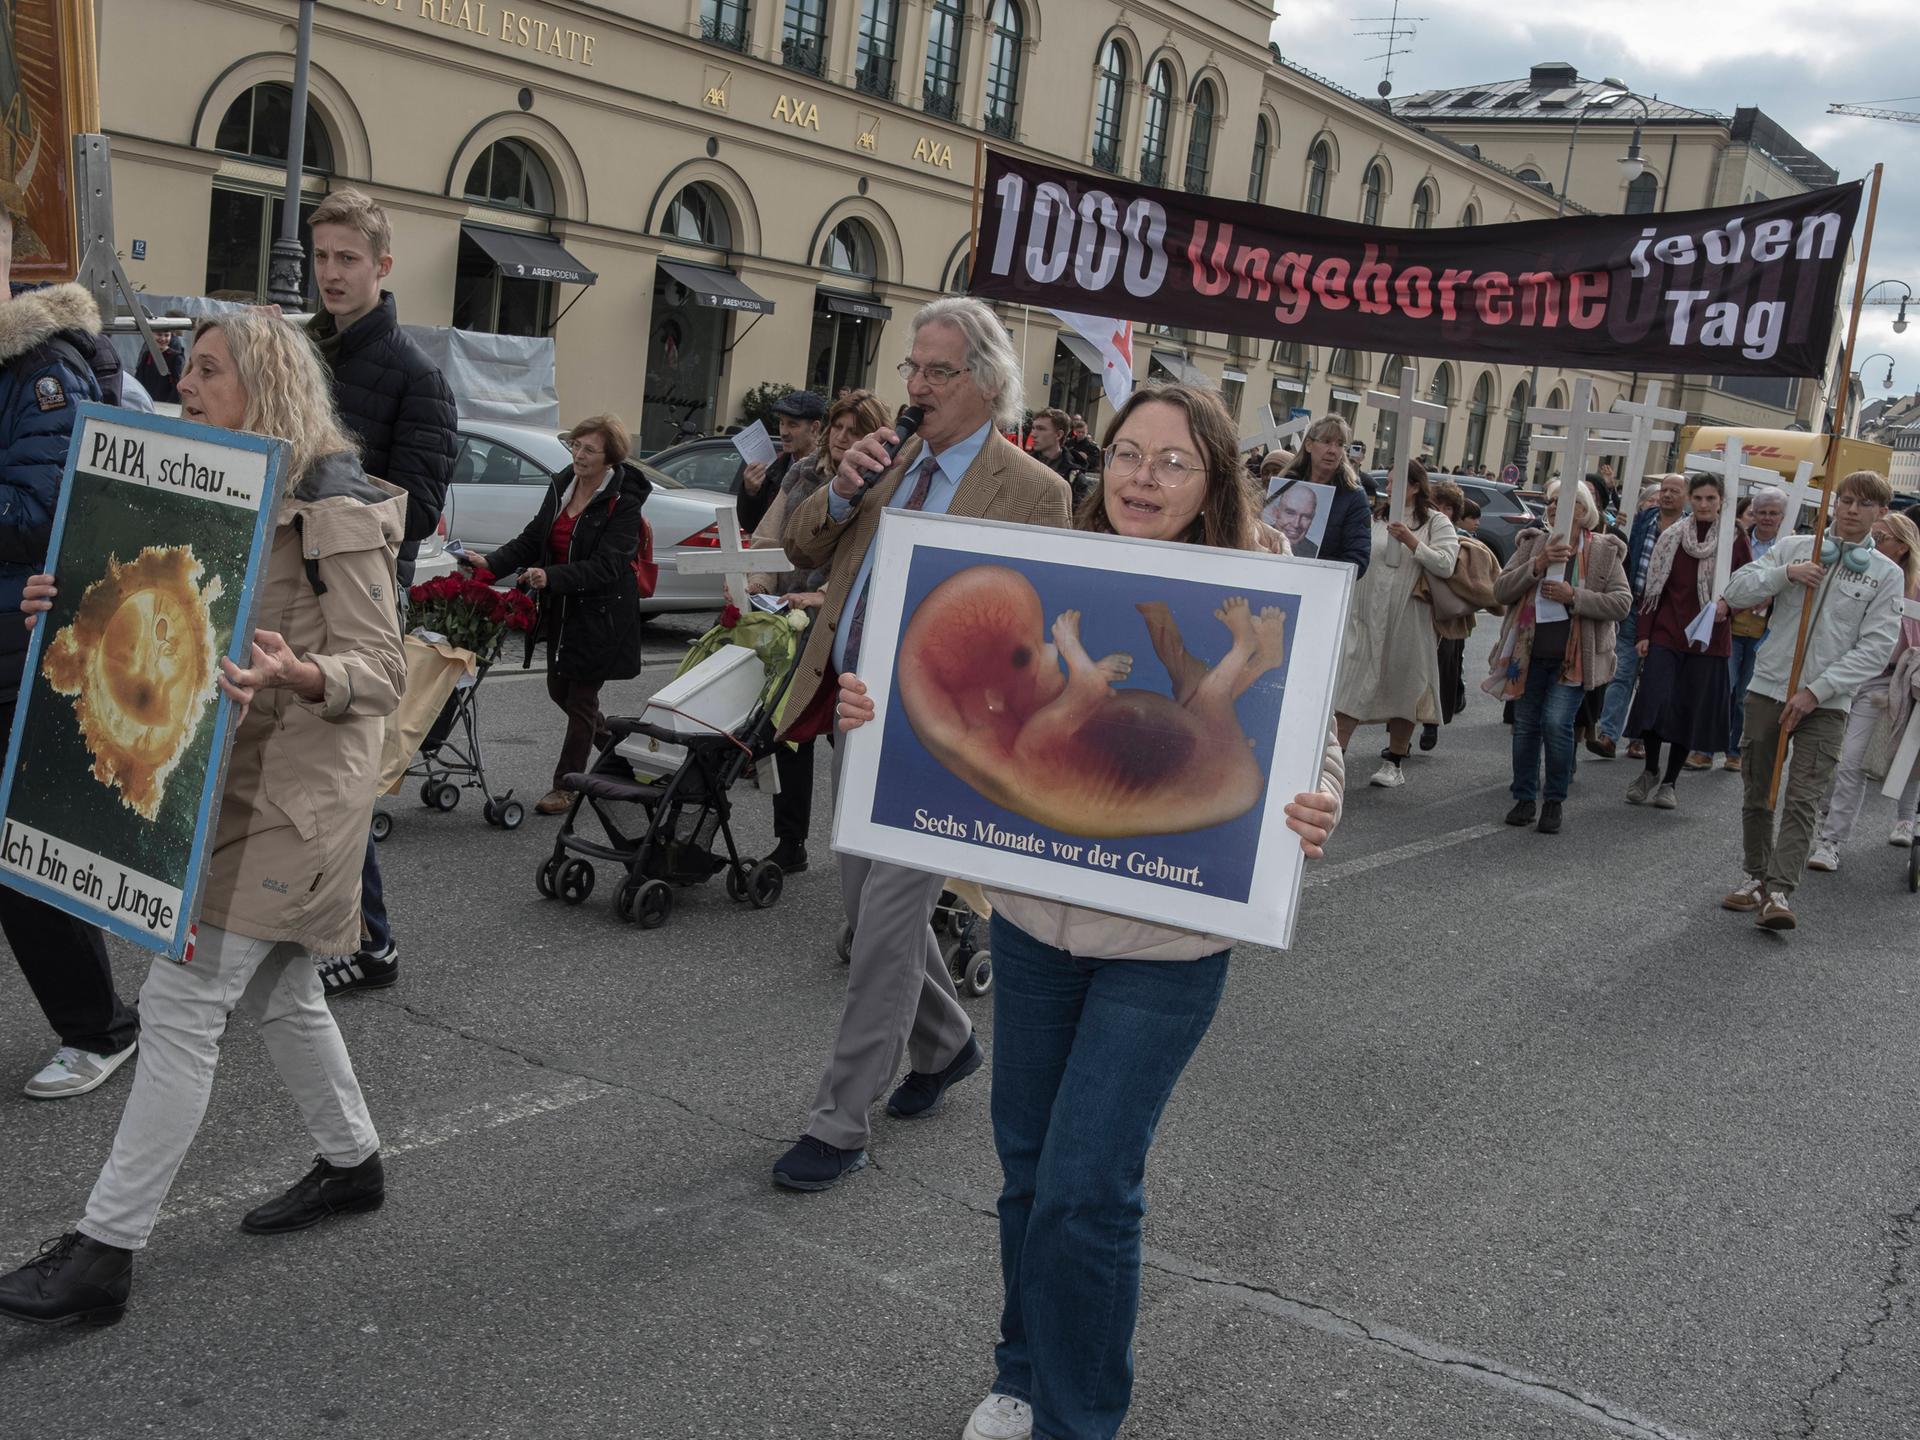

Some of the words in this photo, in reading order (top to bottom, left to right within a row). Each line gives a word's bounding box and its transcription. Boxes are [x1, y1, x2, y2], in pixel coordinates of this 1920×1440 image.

[419, 0, 489, 37] REAL
[499, 10, 596, 66] ESTATE
[704, 87, 726, 108] AXA
[771, 94, 821, 131] AXA
[912, 137, 953, 170] AXA
[135, 241, 145, 251] 12
[991, 171, 1169, 298] 1000
[1187, 218, 1610, 330] Ungeborene
[1629, 212, 1842, 279] jeden
[1664, 290, 1786, 360] Tag
[89, 431, 150, 486] PAPA,
[0, 822, 34, 870] Ich
[36, 838, 68, 885] bin
[72, 863, 103, 900] ein
[107, 872, 173, 930] Junge
[913, 808, 967, 838] Sechs
[972, 820, 1046, 854] Monate
[1051, 841, 1083, 863] vor
[1088, 844, 1121, 870] der
[1126, 851, 1204, 887] Geburt.
